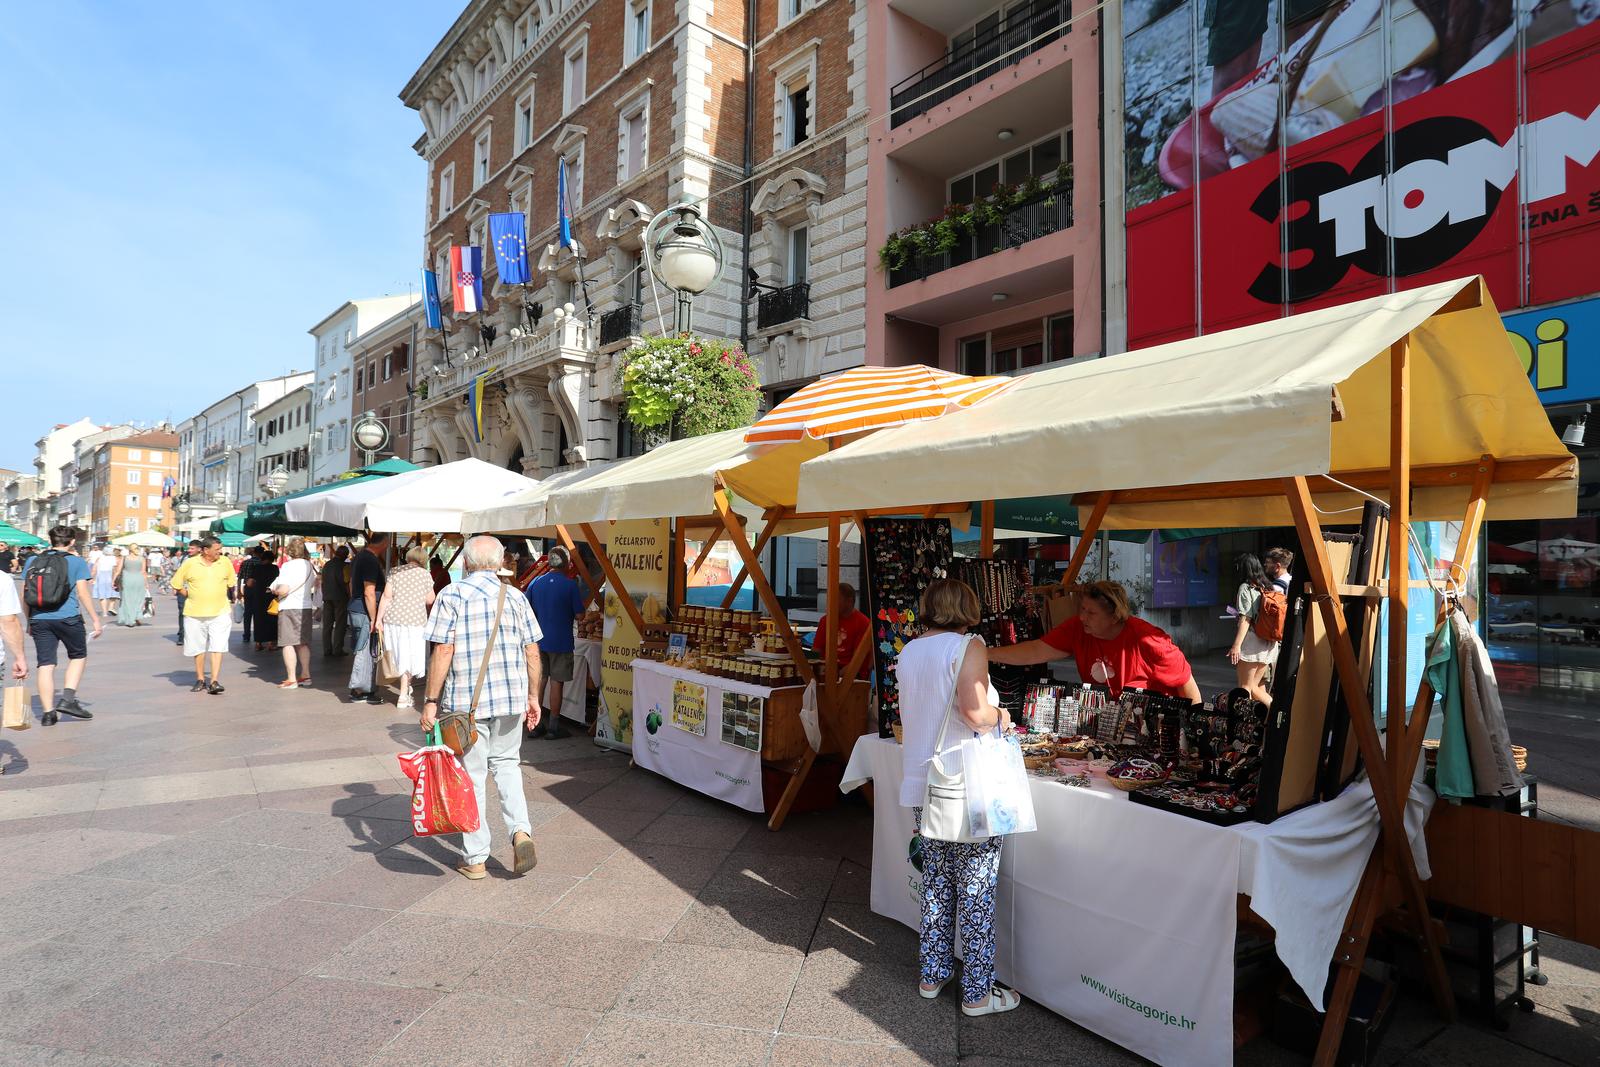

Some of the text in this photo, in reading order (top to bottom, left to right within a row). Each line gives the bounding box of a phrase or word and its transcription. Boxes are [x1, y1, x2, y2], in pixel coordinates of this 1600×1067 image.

[614, 534, 656, 546] PČELARSTVO
[608, 645, 620, 655] SVE
[621, 647, 631, 657] OD
[1080, 973, 1196, 1031] www.visitzagorje.hr
